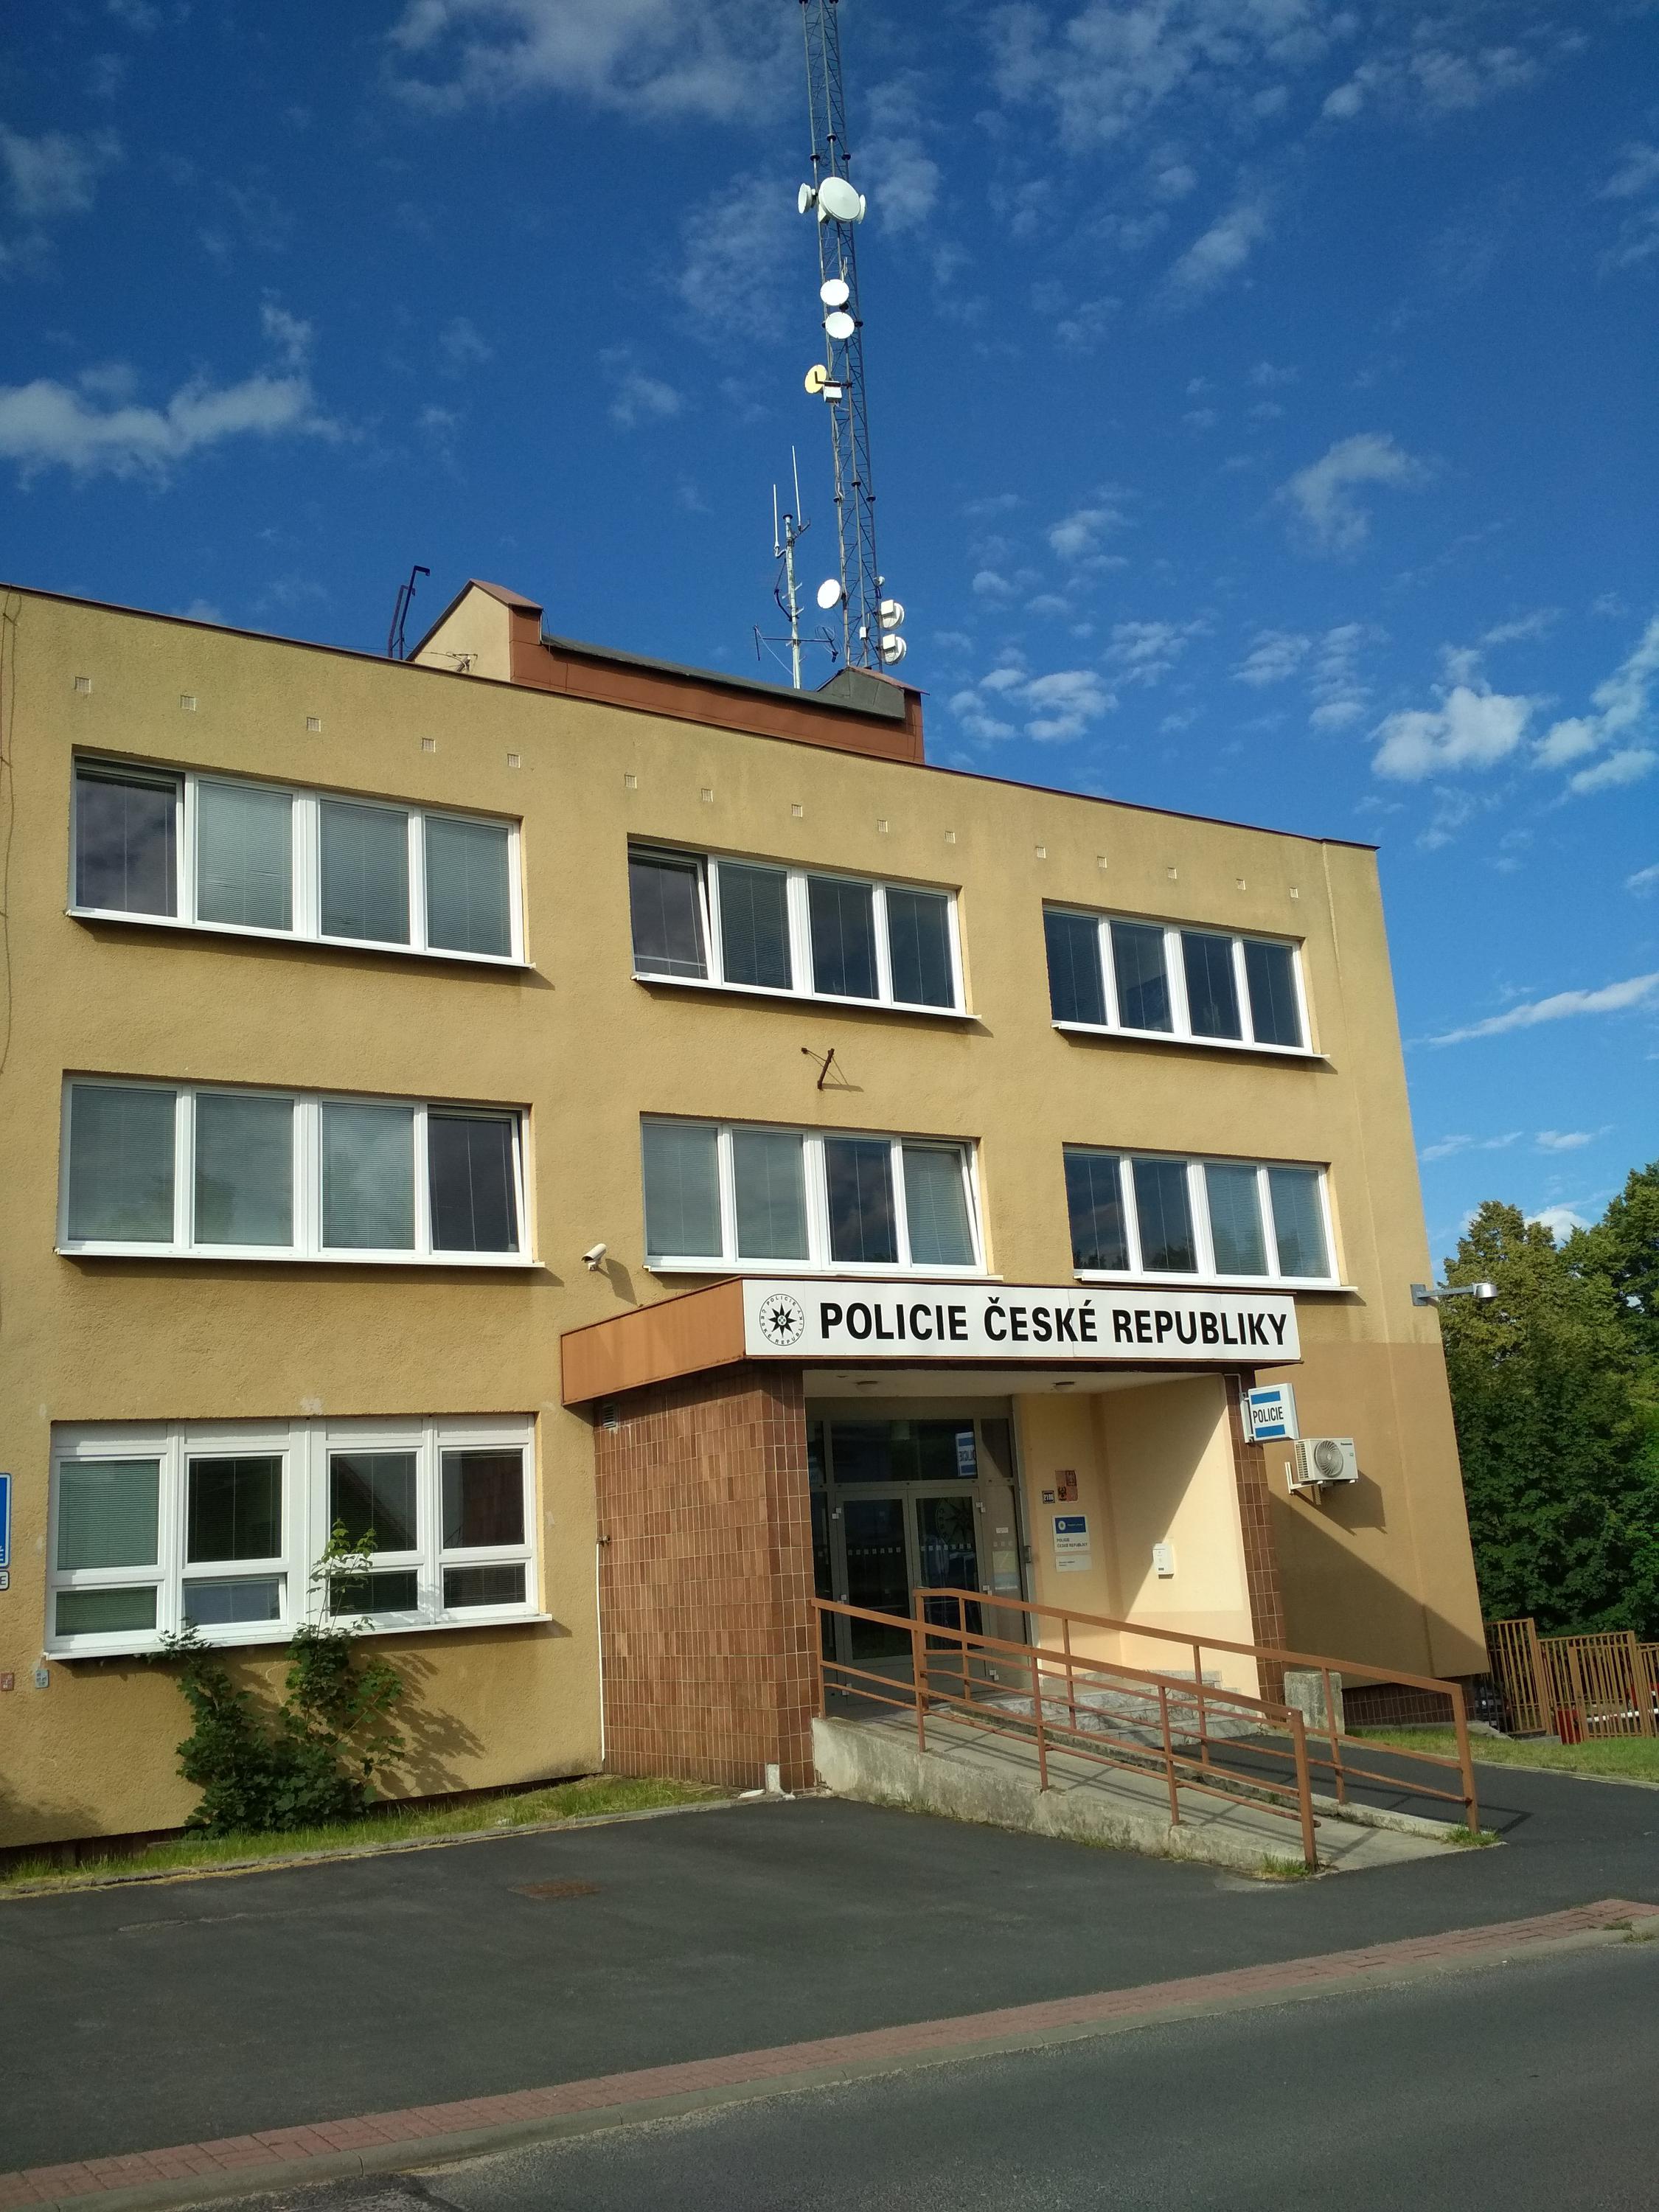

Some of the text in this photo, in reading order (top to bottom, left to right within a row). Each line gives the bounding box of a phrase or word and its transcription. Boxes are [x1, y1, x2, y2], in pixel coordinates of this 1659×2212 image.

[766, 1295, 797, 1307] POLICIE
[774, 1310, 804, 1345] REPUBLIKY
[820, 1296, 1287, 1346] POLICIE ČESKÉ REPUBLIKY
[1253, 1406, 1284, 1424] POLICIE
